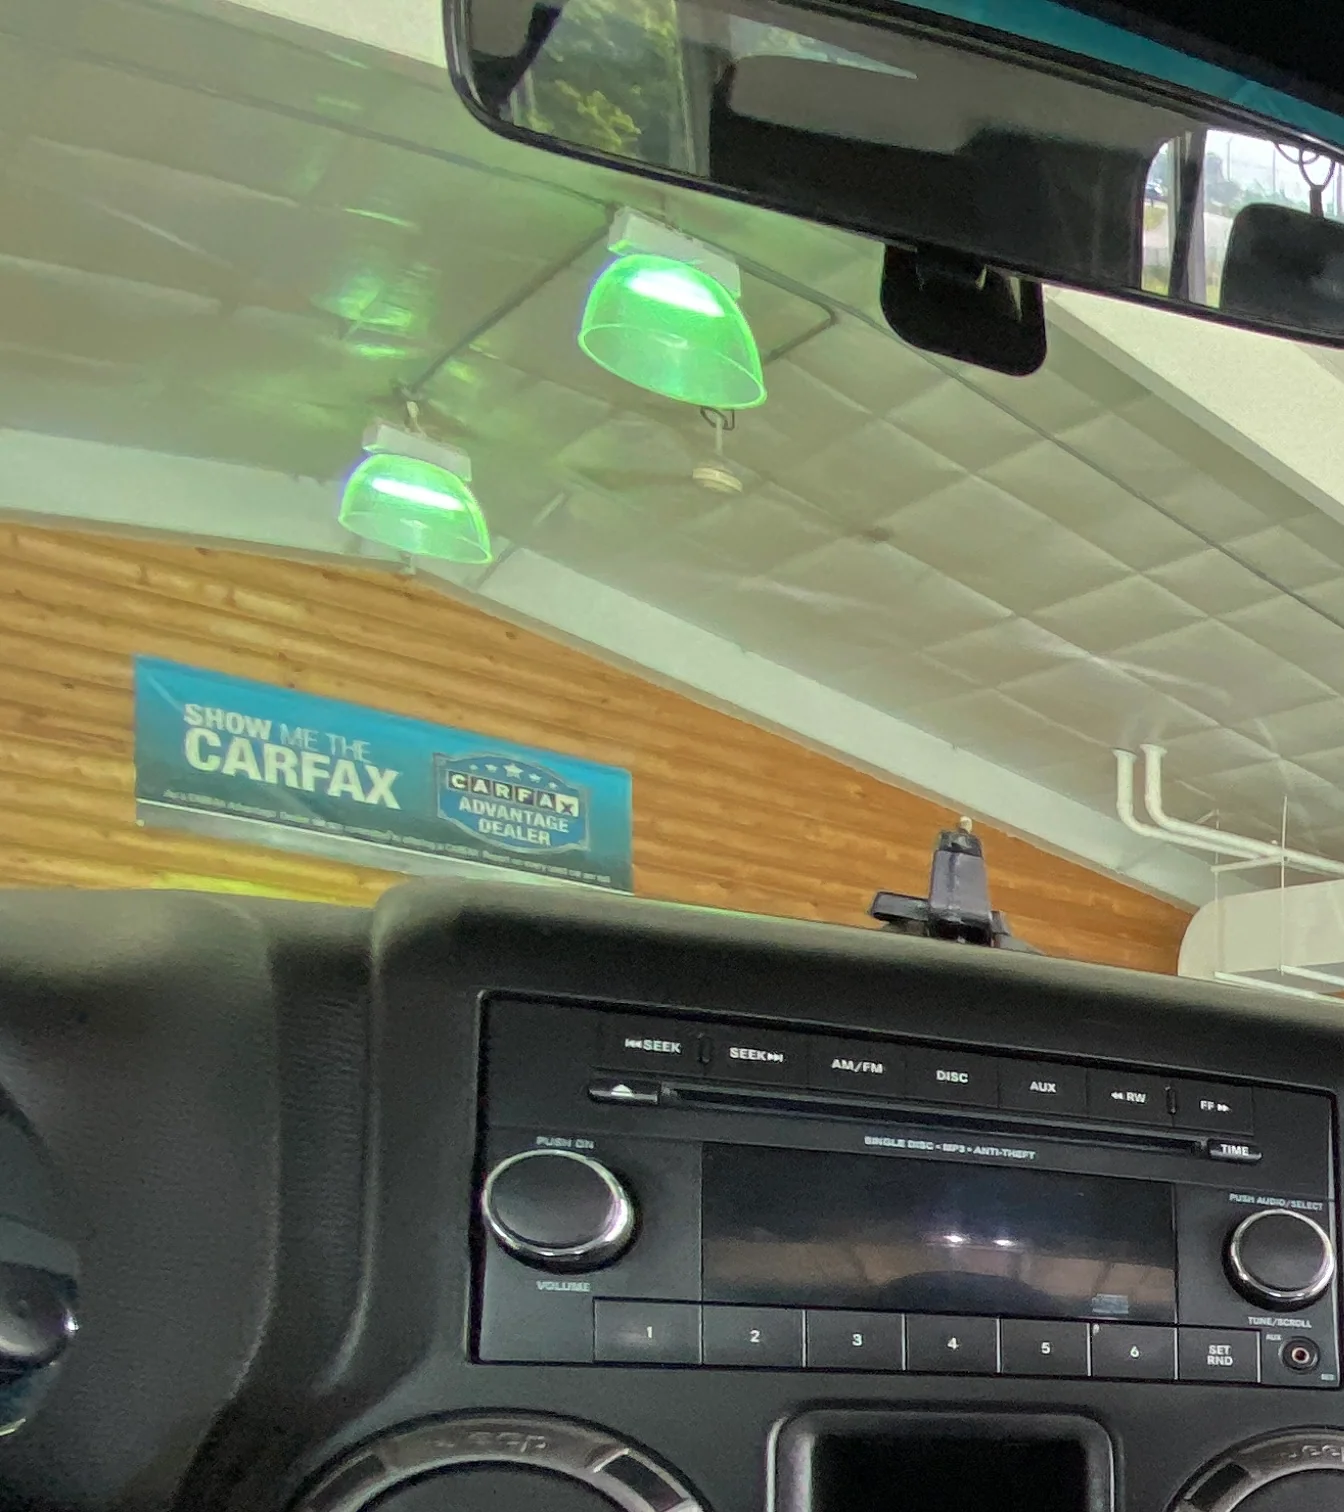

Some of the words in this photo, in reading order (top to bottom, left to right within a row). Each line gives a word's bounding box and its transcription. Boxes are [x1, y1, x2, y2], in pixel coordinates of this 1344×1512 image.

[184, 703, 272, 740] SHOW
[280, 723, 319, 752] ME
[325, 732, 372, 764] THE
[185, 727, 401, 810] CARFAX
[450, 772, 577, 816] CARFAX
[459, 796, 569, 833] ADVANTAGE
[478, 818, 551, 846] DEALER
[642, 1039, 681, 1054] SEEK
[729, 1047, 767, 1062] SEEK
[831, 1058, 883, 1074] AM/FM
[935, 1070, 969, 1084] DISC
[1029, 1080, 1057, 1094] AUX
[1126, 1091, 1147, 1104] RW
[1200, 1100, 1215, 1112] FF
[536, 1136, 572, 1148] PUSH
[575, 1139, 594, 1150] ON
[864, 1135, 906, 1148] SINGLE
[907, 1139, 934, 1151] DISC
[942, 1143, 966, 1154] MP3
[973, 1145, 1037, 1160] ANTI-THEFT
[1220, 1143, 1250, 1156] TIME
[1228, 1192, 1255, 1204] PUSH
[1256, 1196, 1324, 1211] AUDIO/SELECT
[536, 1281, 591, 1293] VOLUME
[646, 1326, 653, 1338] 1
[750, 1330, 760, 1342] 2
[1265, 1333, 1282, 1341] AUX
[852, 1333, 863, 1346] 3
[947, 1337, 959, 1349] 4
[1041, 1342, 1050, 1354] 5
[1130, 1346, 1140, 1358] 6
[1208, 1345, 1232, 1355] SET
[1206, 1355, 1234, 1366] RND
